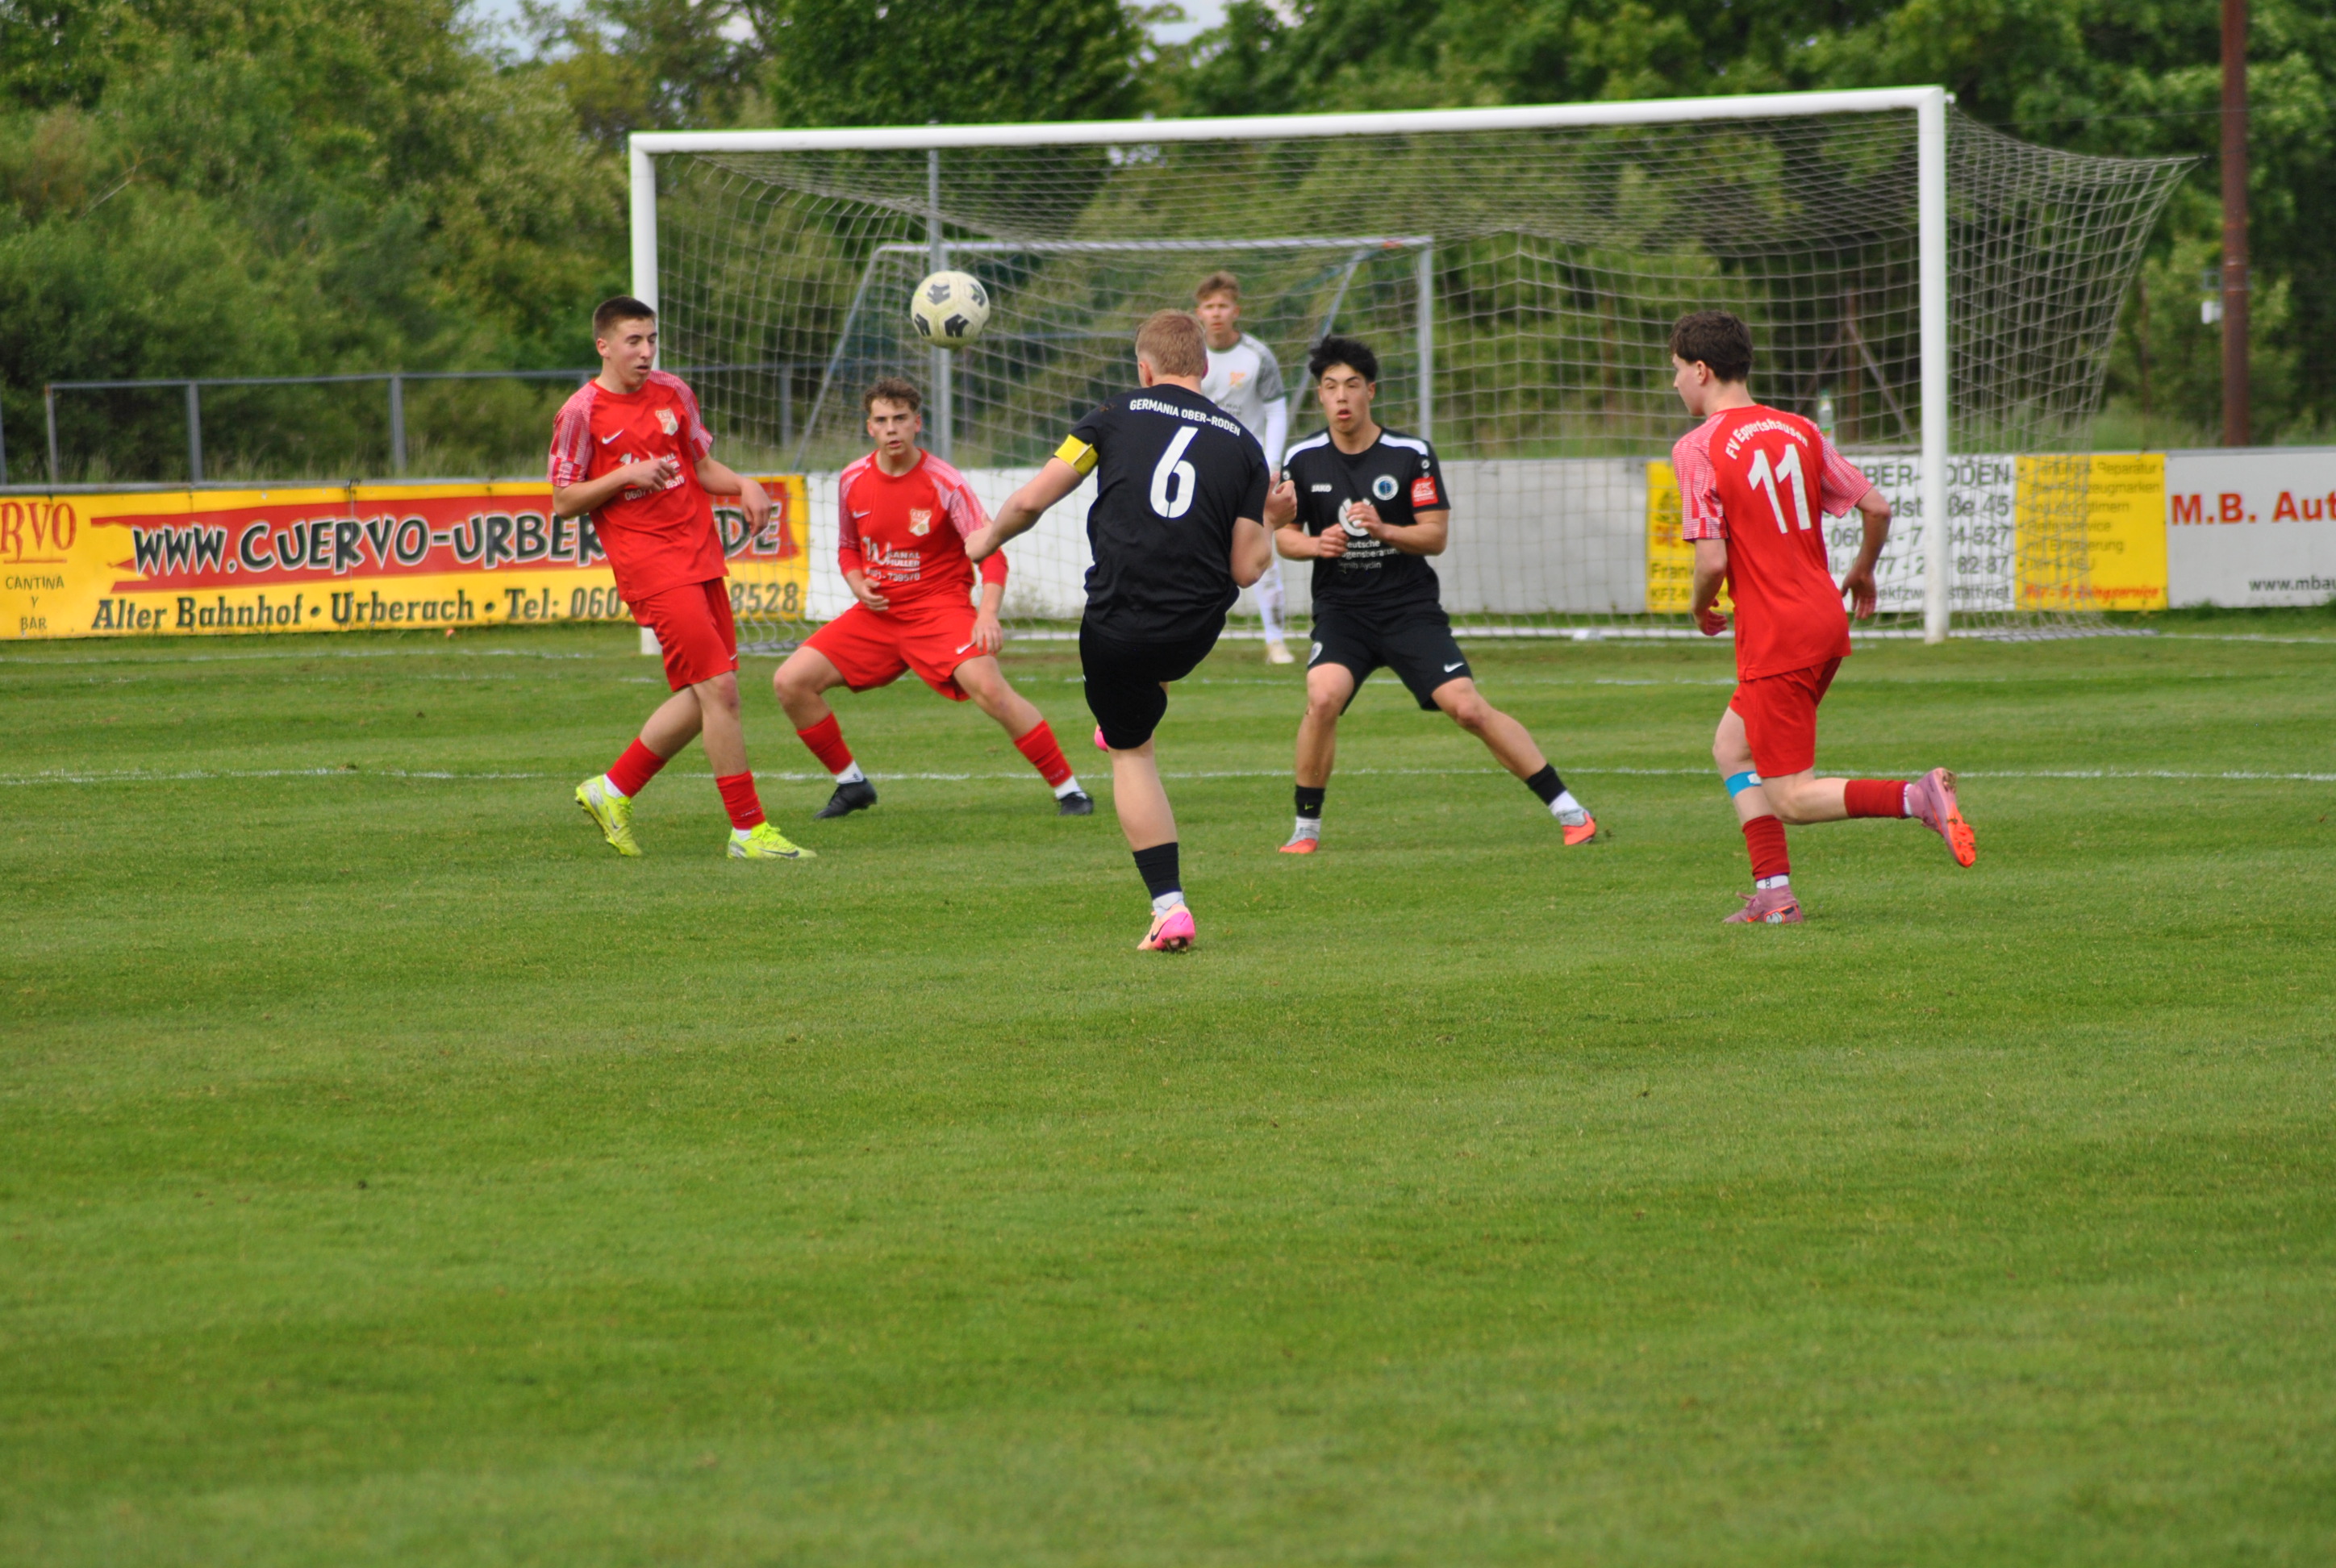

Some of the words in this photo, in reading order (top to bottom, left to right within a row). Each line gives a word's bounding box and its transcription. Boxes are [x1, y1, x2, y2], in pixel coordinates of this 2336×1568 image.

[1129, 398, 1179, 417] GERMANIA
[1181, 409, 1241, 436] OBER-RODEN
[1725, 438, 1741, 460] FV
[1733, 418, 1808, 448] Eppertshausen
[1150, 426, 1196, 519] 6
[1863, 464, 2009, 487] BER-ODEN
[1311, 484, 1333, 493] JAKO
[1747, 444, 1812, 534] 11
[1983, 494, 2009, 516] 45
[2171, 492, 2257, 525] M.B.
[131, 502, 782, 576] WWW.CUERVO-URBERDE
[1347, 540, 1380, 548] eutsche
[6, 574, 65, 590] CANTINA
[31, 595, 40, 609] Y
[91, 598, 168, 630] Alter
[176, 594, 304, 628] Bahnhof
[331, 588, 474, 624] Urberach
[21, 616, 48, 632] BAR
